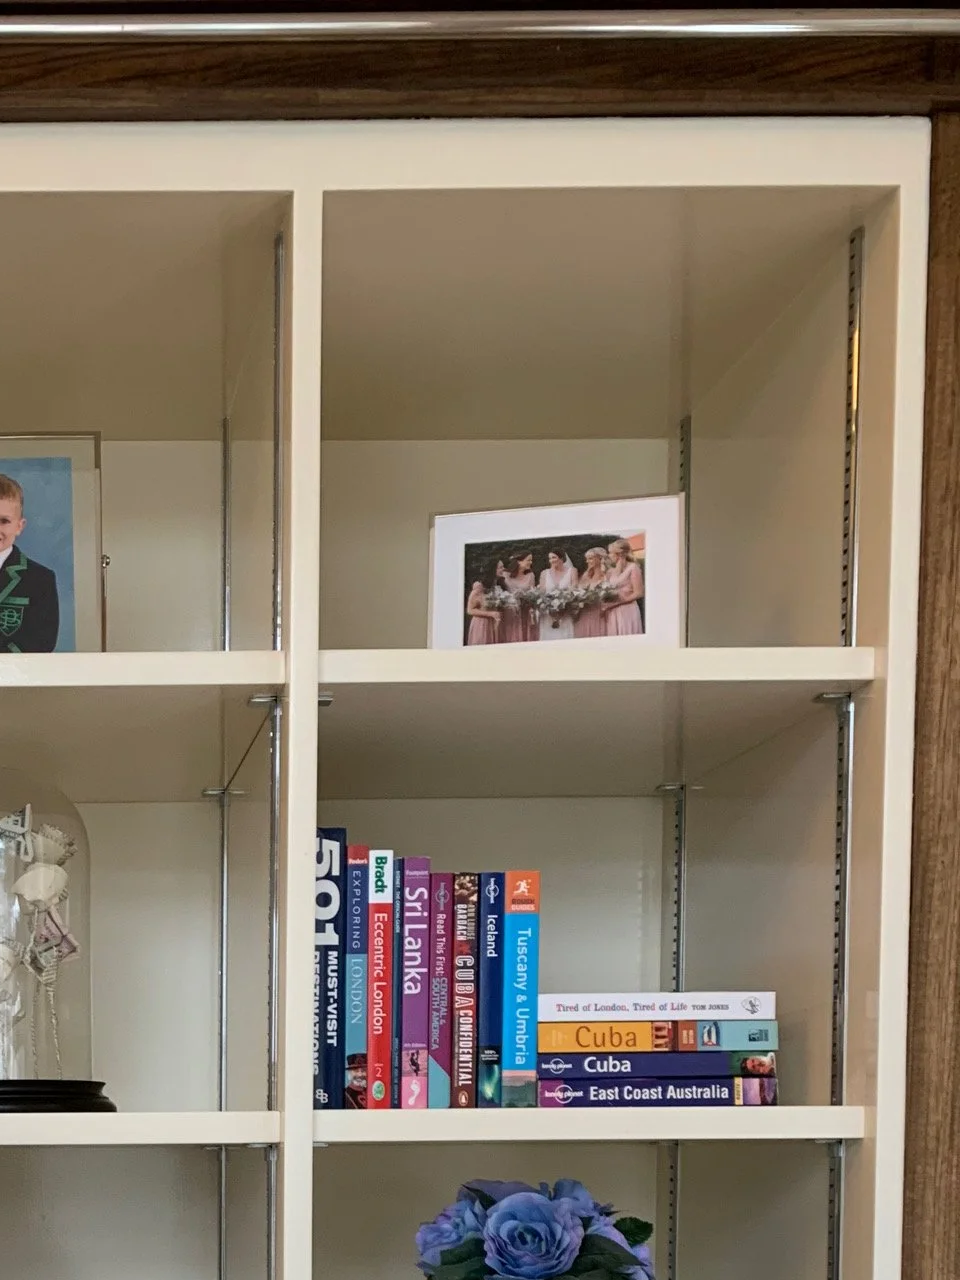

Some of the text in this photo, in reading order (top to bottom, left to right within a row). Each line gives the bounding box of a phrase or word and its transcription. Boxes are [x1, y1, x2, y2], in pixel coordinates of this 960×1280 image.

[315, 837, 341, 946] 501
[375, 856, 388, 894] Bradt
[352, 870, 362, 949] EXPLORING
[404, 887, 428, 917] Sri
[436, 913, 447, 935] Read
[436, 937, 447, 954] This
[486, 914, 499, 957] Iceland
[373, 913, 388, 1035] Eccentric London
[403, 923, 428, 995] Lanka
[327, 950, 339, 1047] MUST-VISIT
[351, 958, 362, 1025] LONDON
[439, 977, 448, 1018] CENTRAL
[514, 928, 531, 1065] Tuscany & Umbria
[556, 1002, 688, 1013] Tired of London, Tired of Life
[431, 977, 440, 1050] SOUTH AMERICA
[455, 955, 475, 1086] CUBA CONFIDENTIAL
[575, 1025, 637, 1048] Cuba
[583, 1055, 632, 1073] Cuba
[590, 1085, 729, 1100] East Coast Australia
